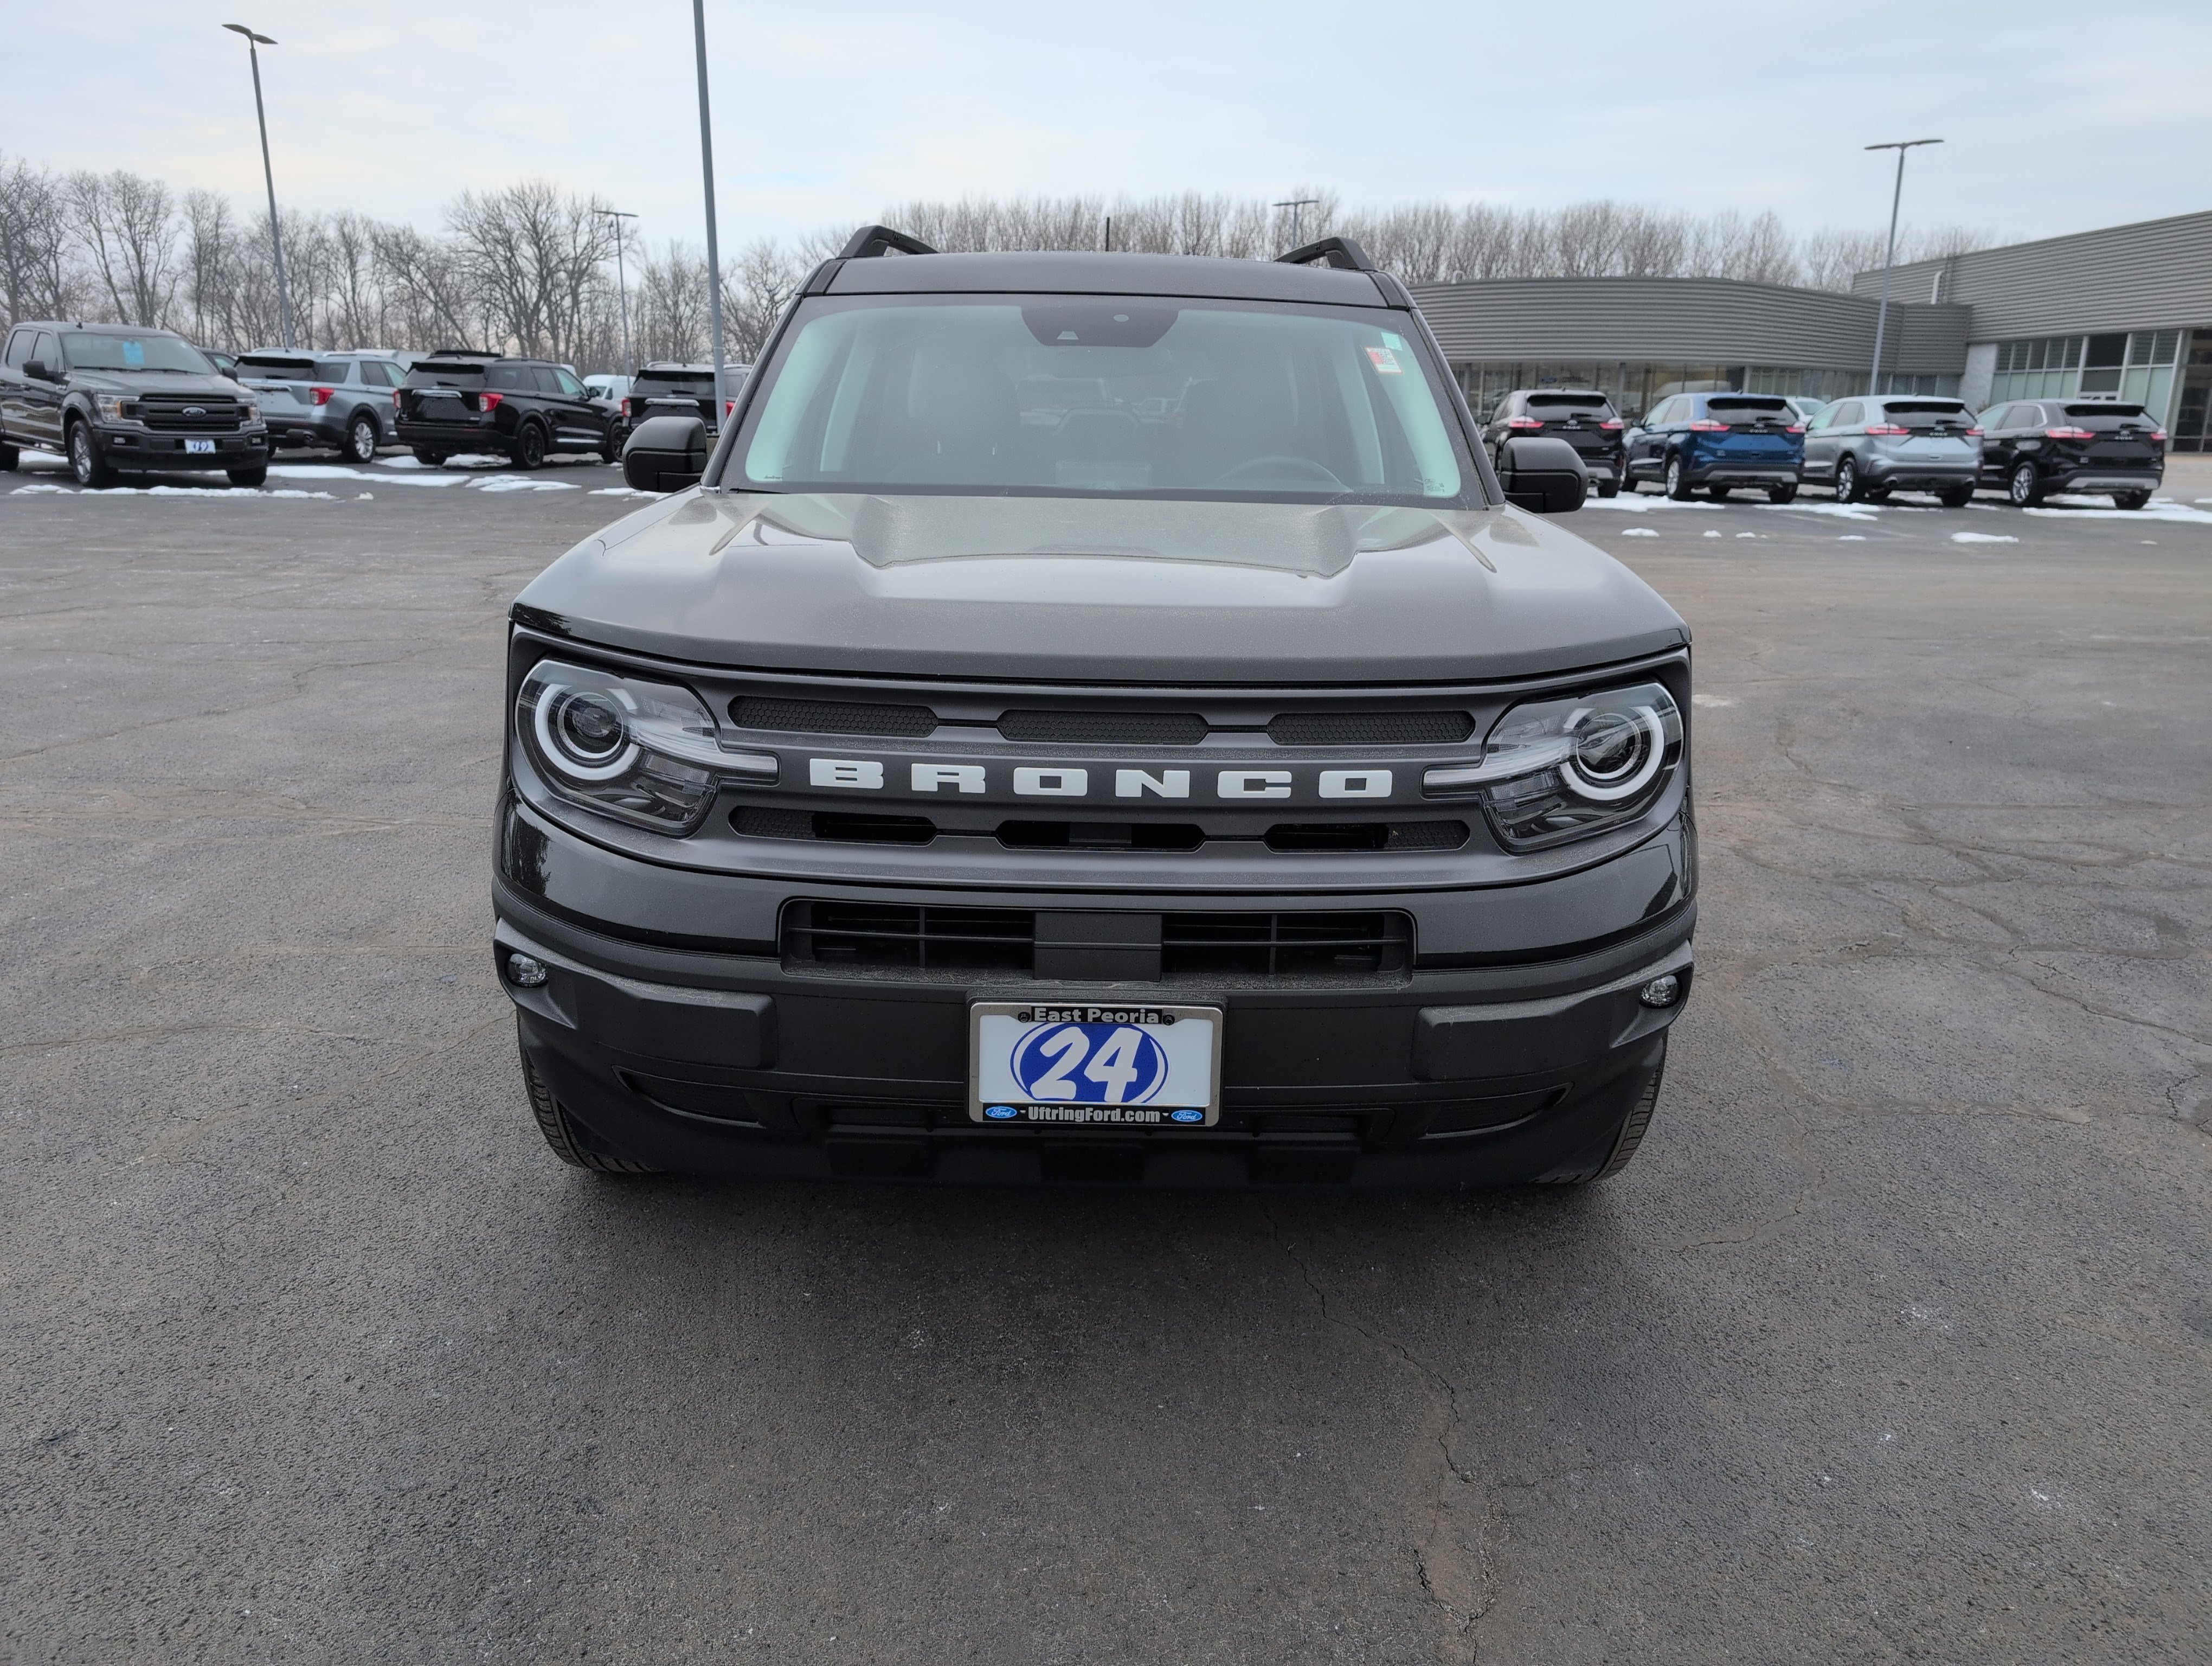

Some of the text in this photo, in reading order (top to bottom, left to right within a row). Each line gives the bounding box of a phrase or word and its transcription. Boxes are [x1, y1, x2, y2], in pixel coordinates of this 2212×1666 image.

[809, 758, 1393, 799] BRONCO
[1034, 1007, 1159, 1023] East Peoria
[1030, 1026, 1143, 1103] 24
[991, 1107, 1012, 1117] Ford
[1028, 1106, 1161, 1123] UftringFord.com
[1176, 1111, 1197, 1120] Ford
